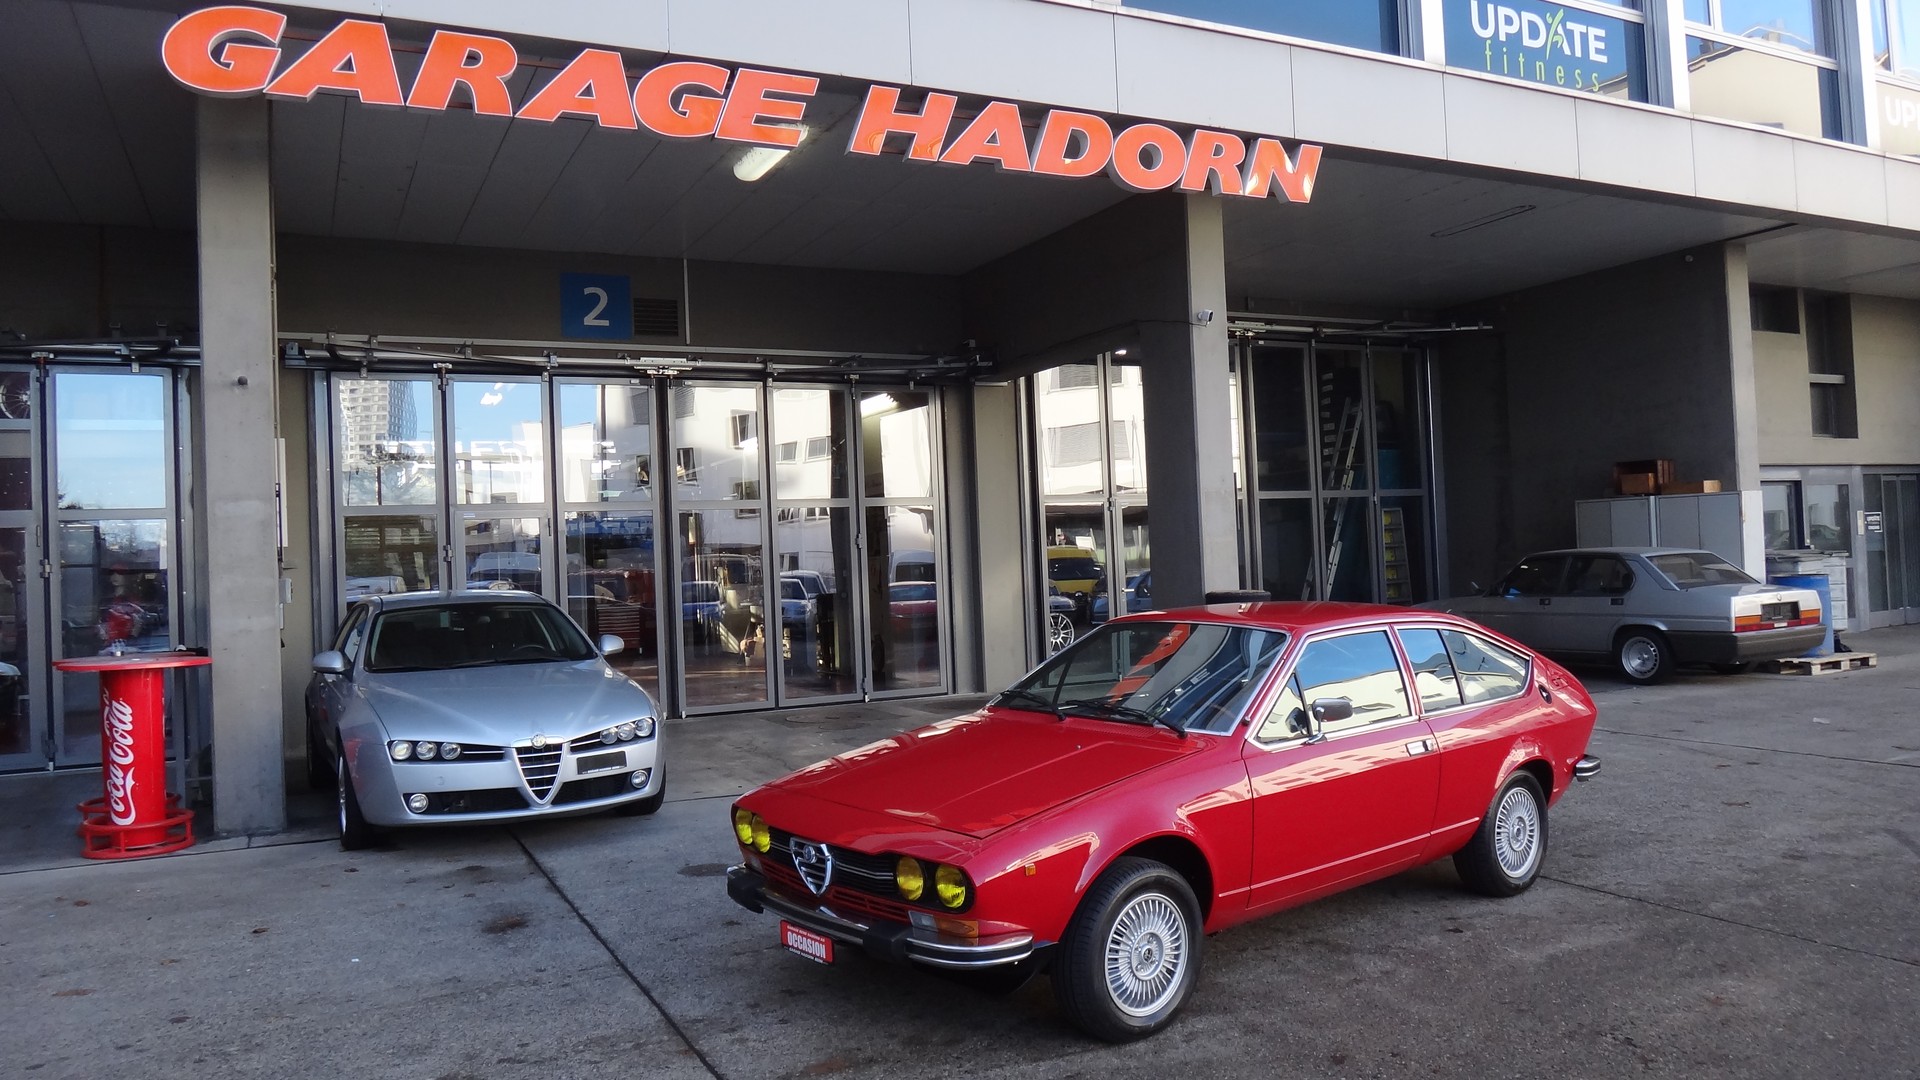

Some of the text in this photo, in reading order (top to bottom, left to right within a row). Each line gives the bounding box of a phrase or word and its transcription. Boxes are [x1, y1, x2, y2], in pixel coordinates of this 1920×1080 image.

[1470, 0, 1608, 63] UPDATE
[1485, 39, 1600, 92] fitness
[161, 5, 1324, 204] GARAGE HADORN
[1885, 95, 1920, 131] UP
[583, 286, 610, 326] 2
[787, 931, 826, 959] OCCASION
